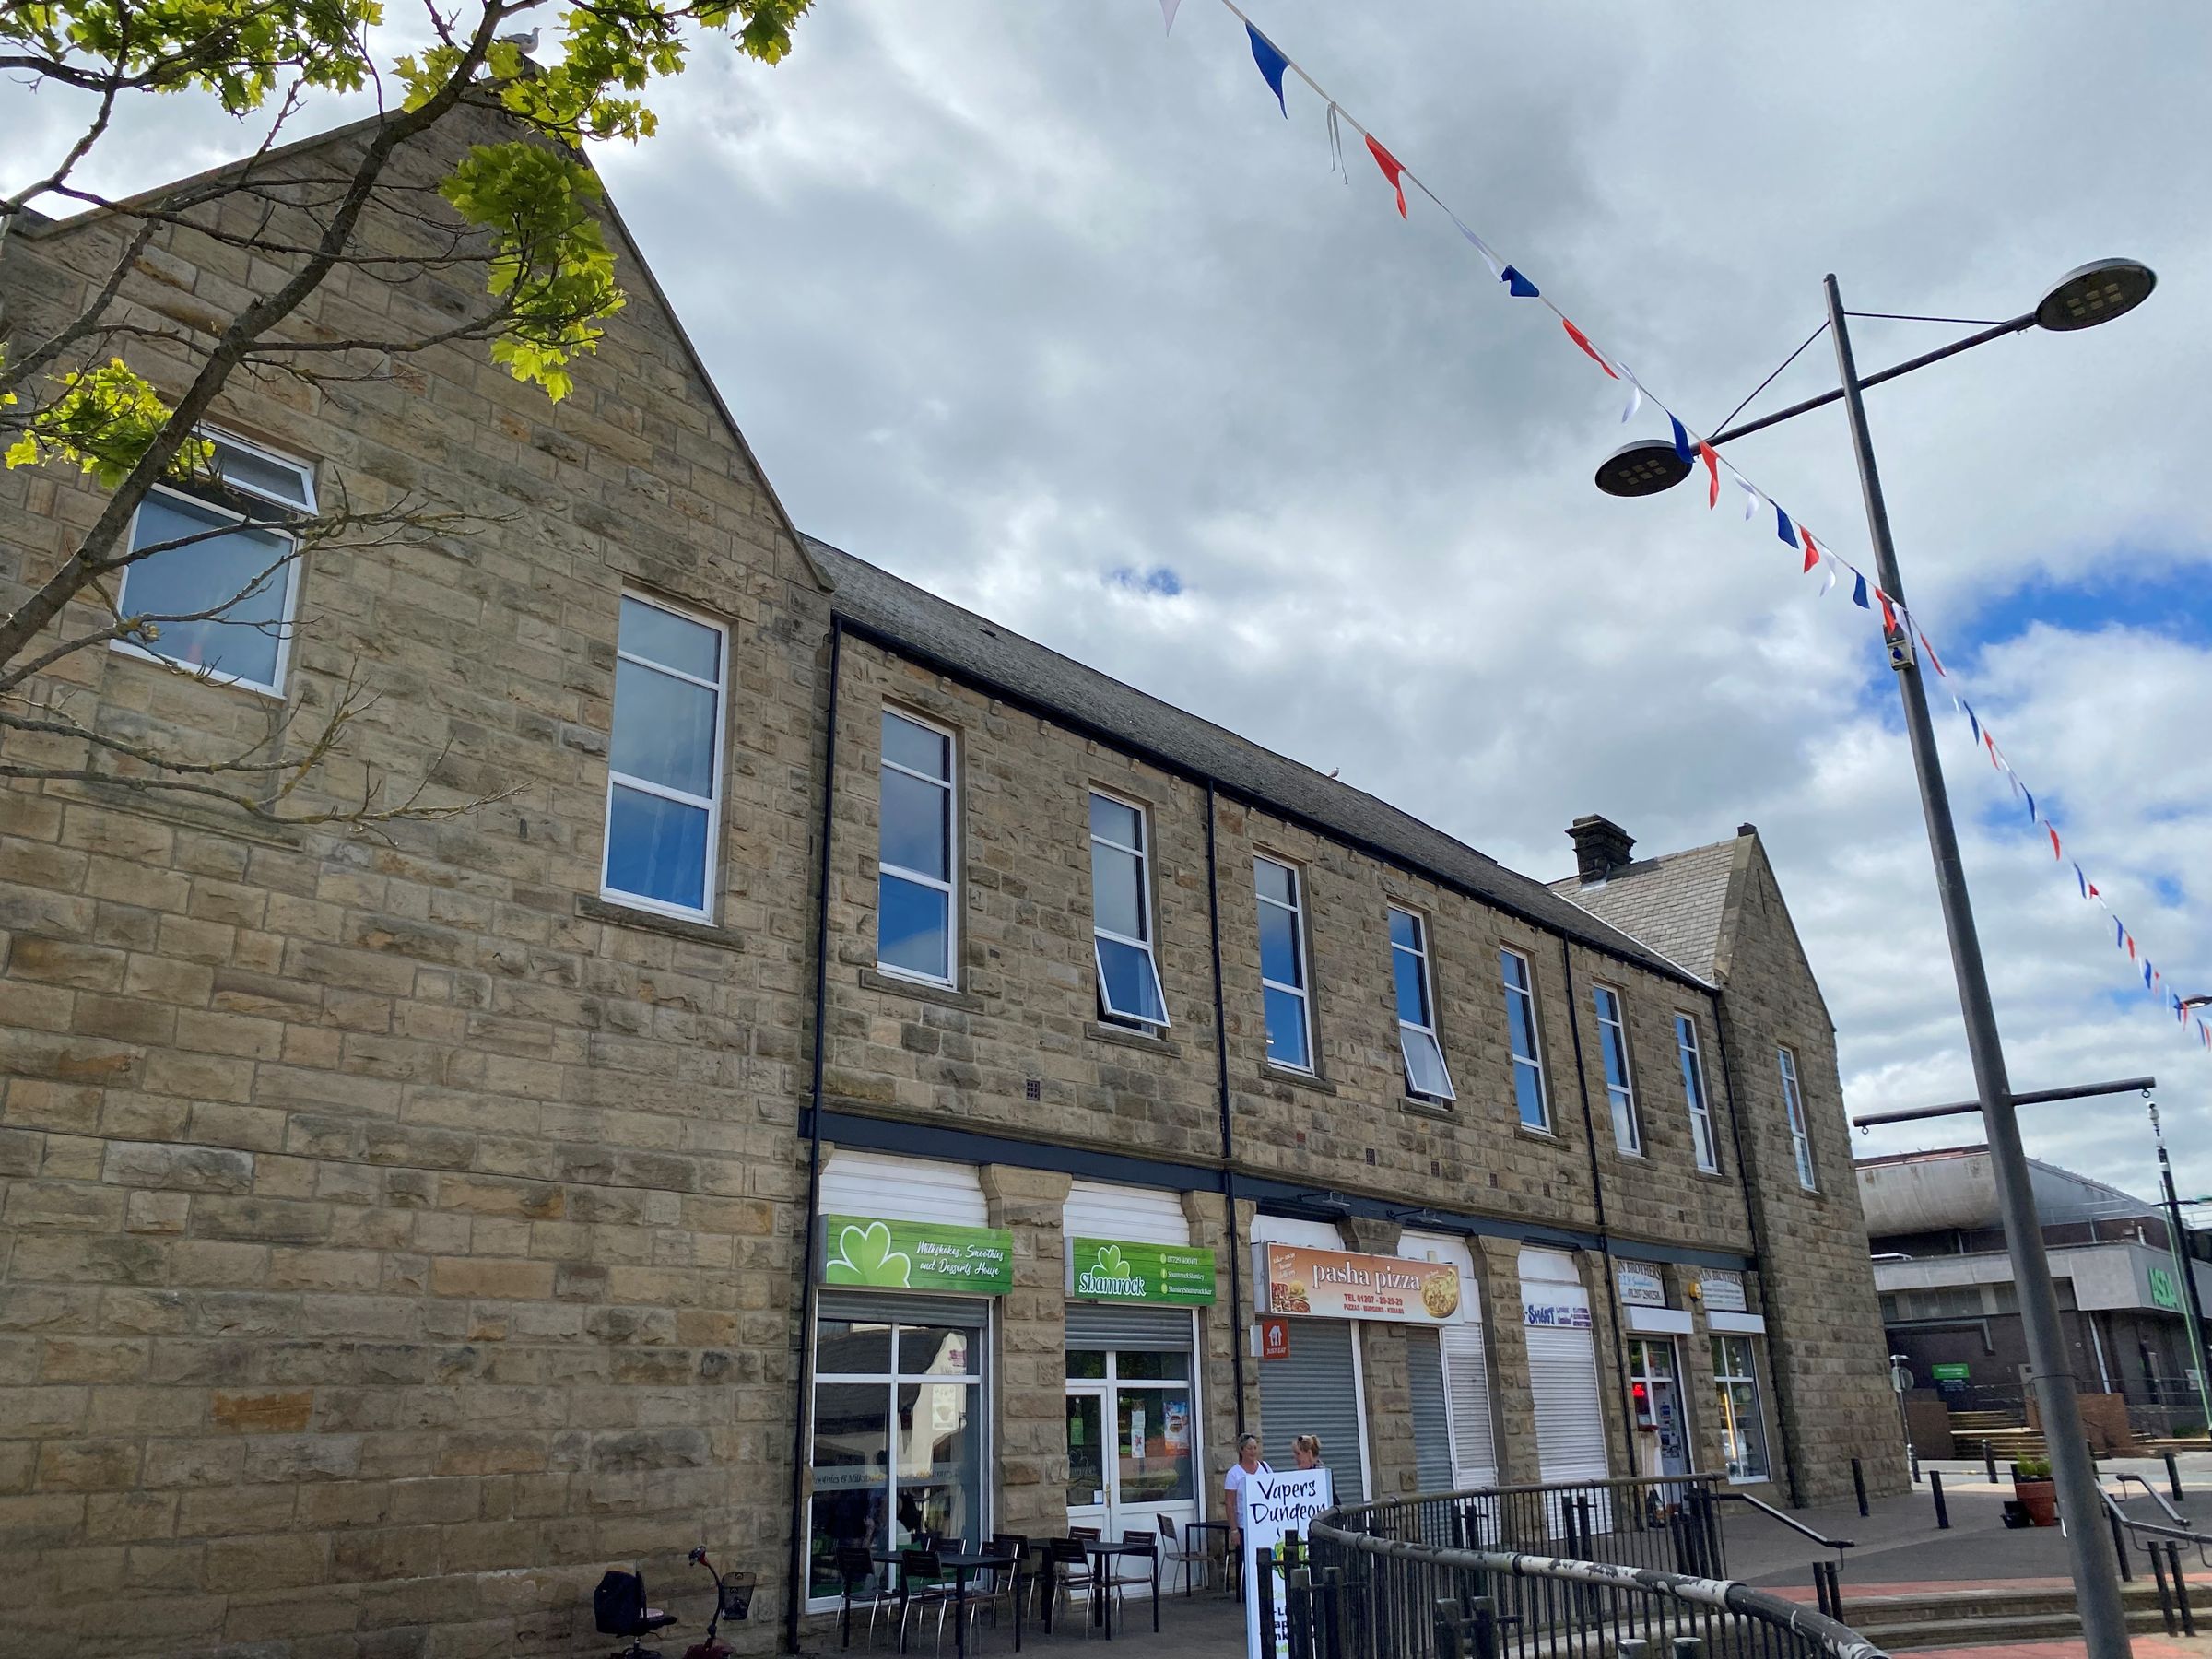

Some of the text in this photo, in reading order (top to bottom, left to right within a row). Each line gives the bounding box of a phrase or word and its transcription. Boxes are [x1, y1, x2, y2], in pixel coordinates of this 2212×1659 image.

[965, 1244, 1004, 1261] Smoothies
[920, 1258, 1000, 1277] and Desserts House
[1312, 1261, 1421, 1294] pasha pizza
[1078, 1271, 1147, 1297] Shamrock
[1344, 1293, 1356, 1302] TEL
[1256, 1477, 1317, 1506] Vapers
[1249, 1503, 1325, 1531] Dungeon
